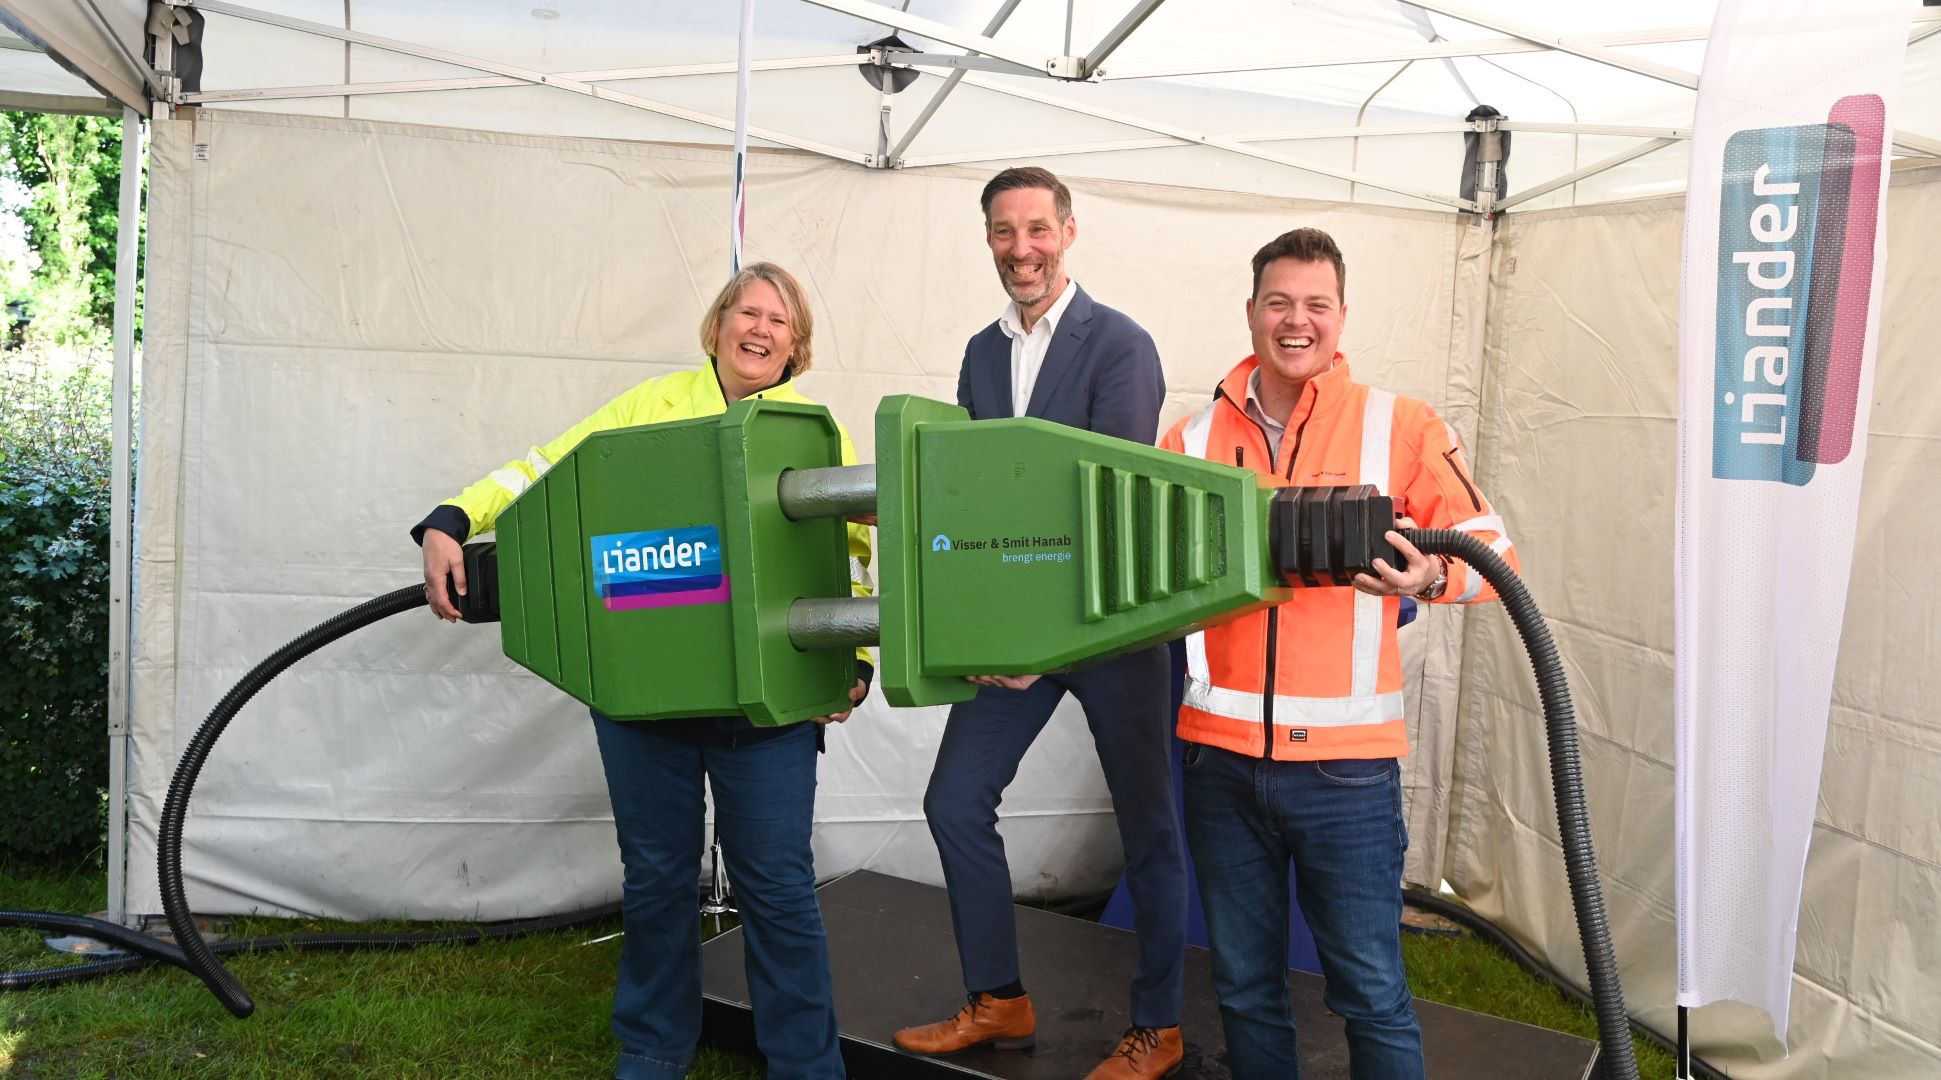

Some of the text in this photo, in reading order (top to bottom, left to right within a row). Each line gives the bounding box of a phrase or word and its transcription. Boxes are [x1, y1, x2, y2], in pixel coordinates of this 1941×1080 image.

[1724, 163, 1801, 446] Liander
[603, 536, 708, 574] Liander
[952, 534, 1072, 550] Visser & Smit Hanab
[1002, 551, 1071, 564] brengt energie
